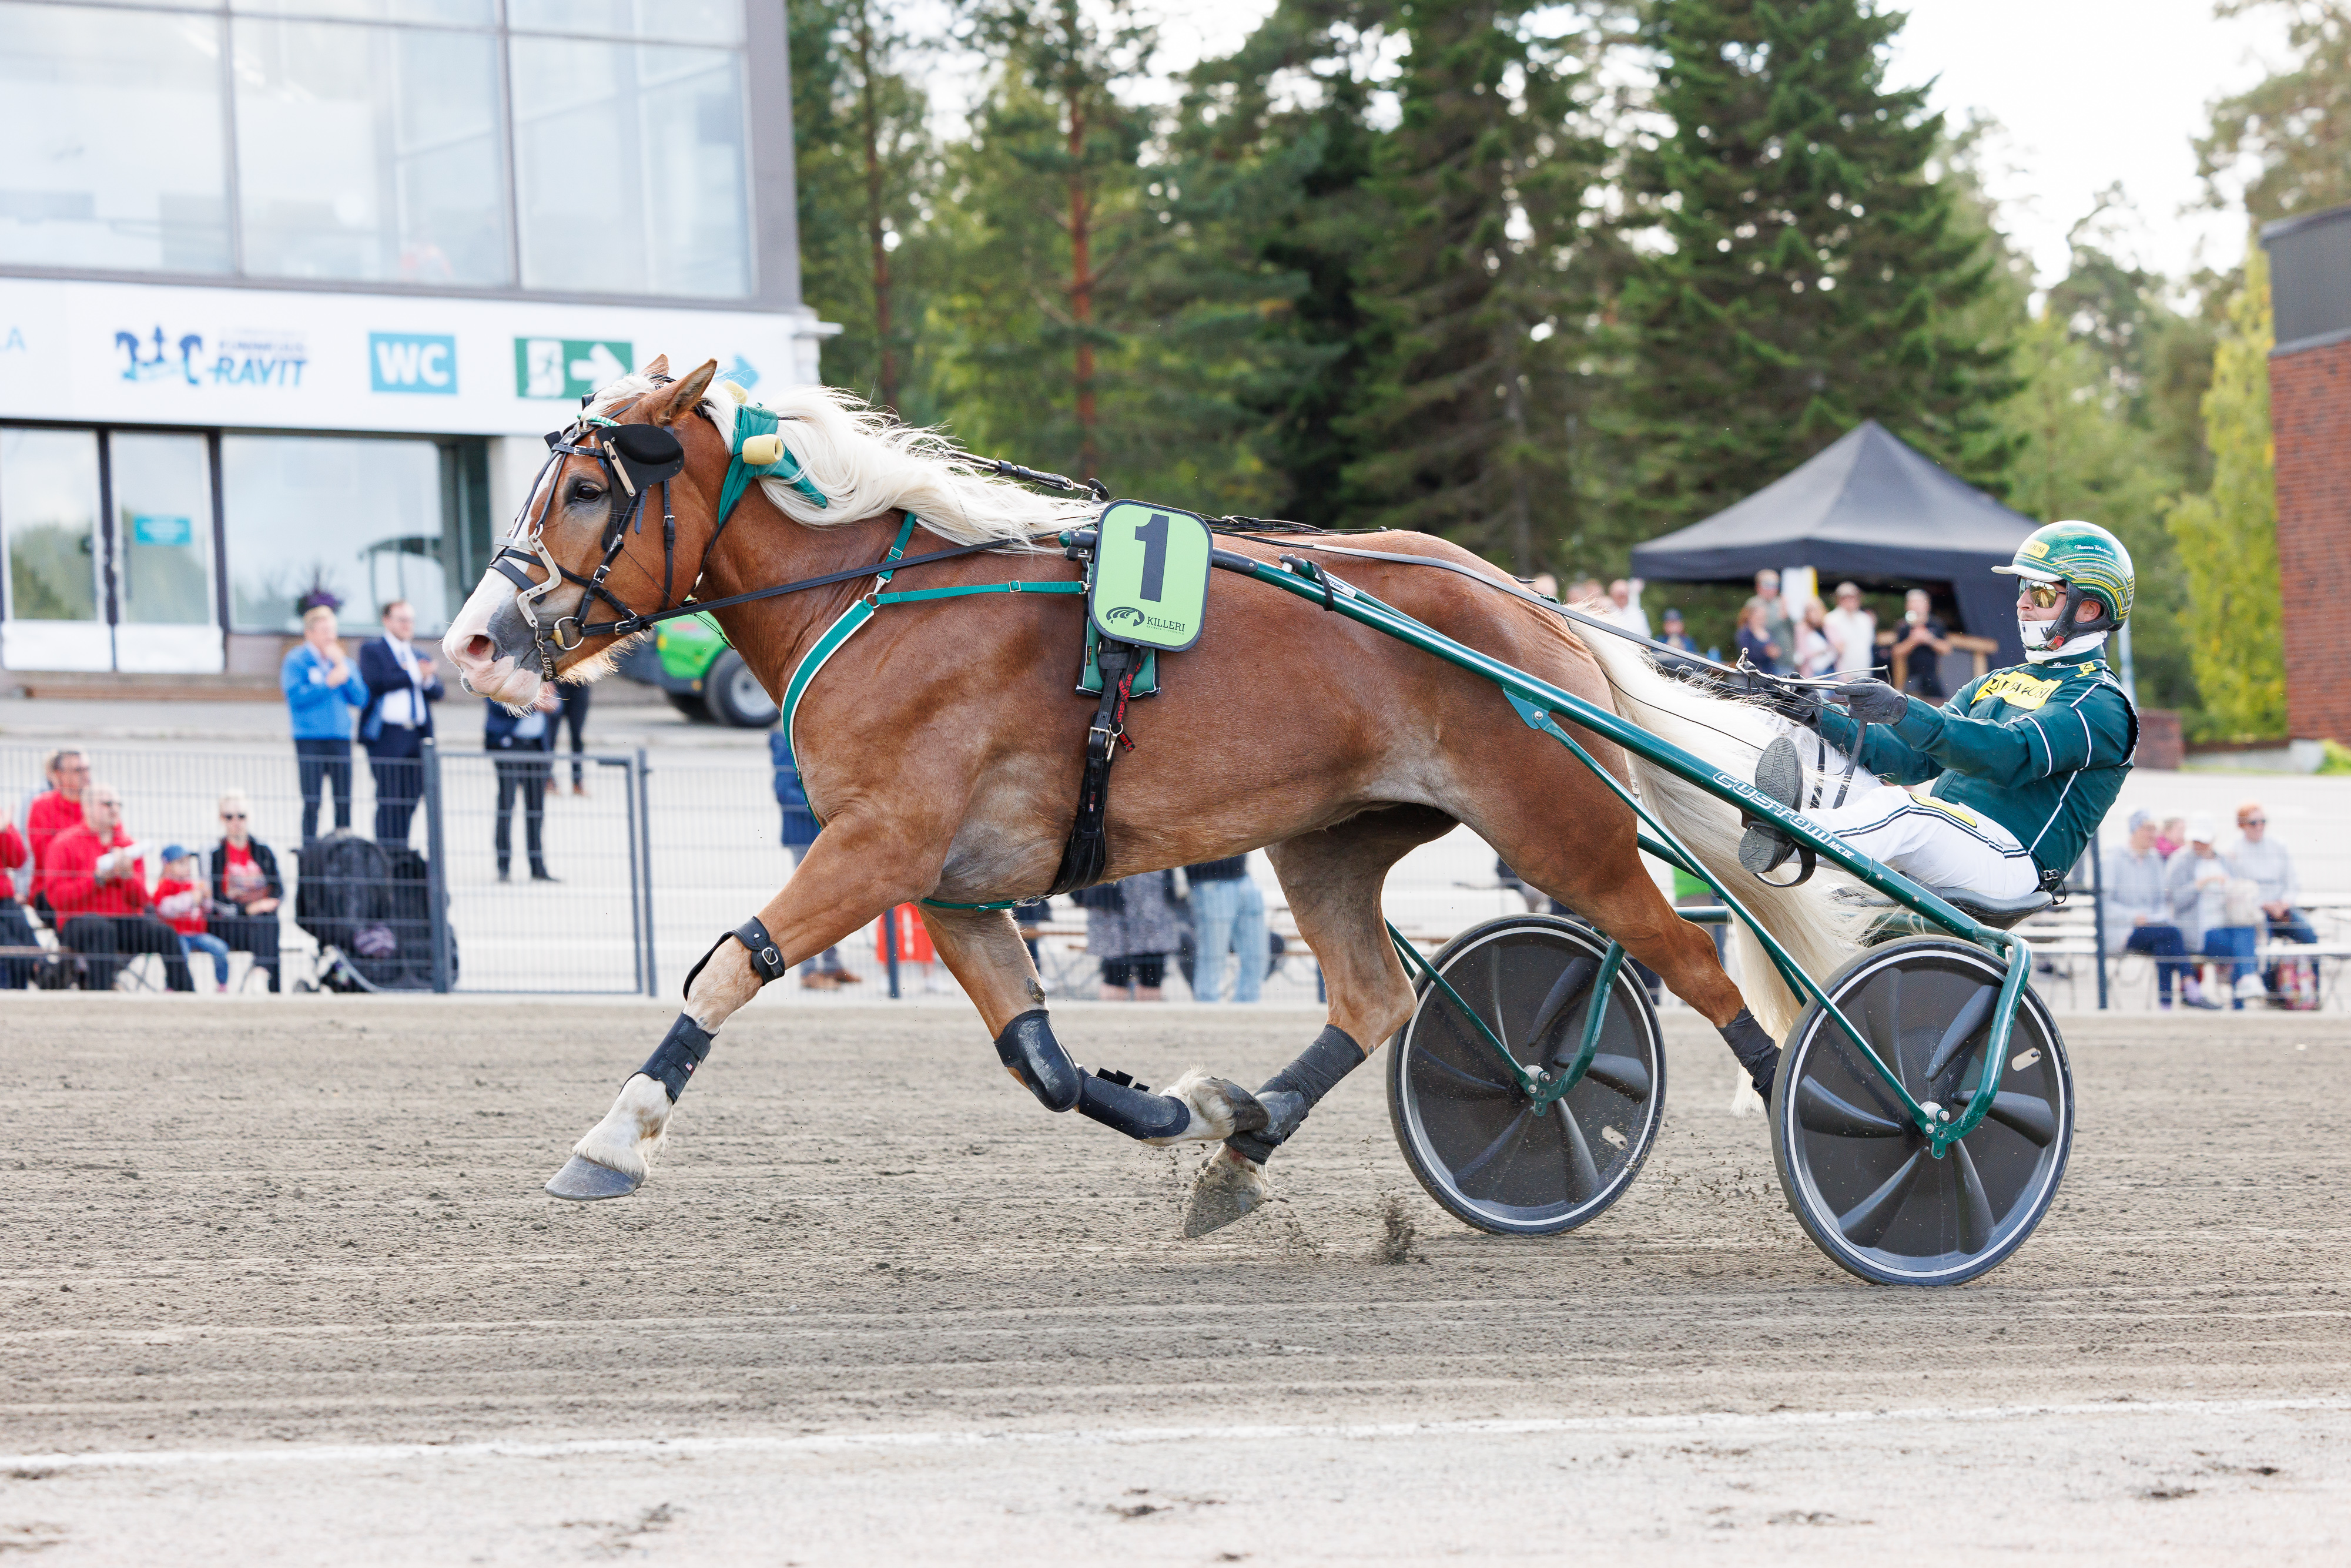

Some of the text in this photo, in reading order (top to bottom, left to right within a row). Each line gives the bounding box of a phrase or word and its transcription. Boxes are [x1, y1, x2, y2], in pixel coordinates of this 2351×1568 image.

[377, 341, 450, 386] WC
[1134, 513, 1170, 602] 1
[1326, 578, 1344, 589] STOM
[1147, 617, 1185, 632] KILLERI
[1712, 771, 1832, 844] CUSTOM
